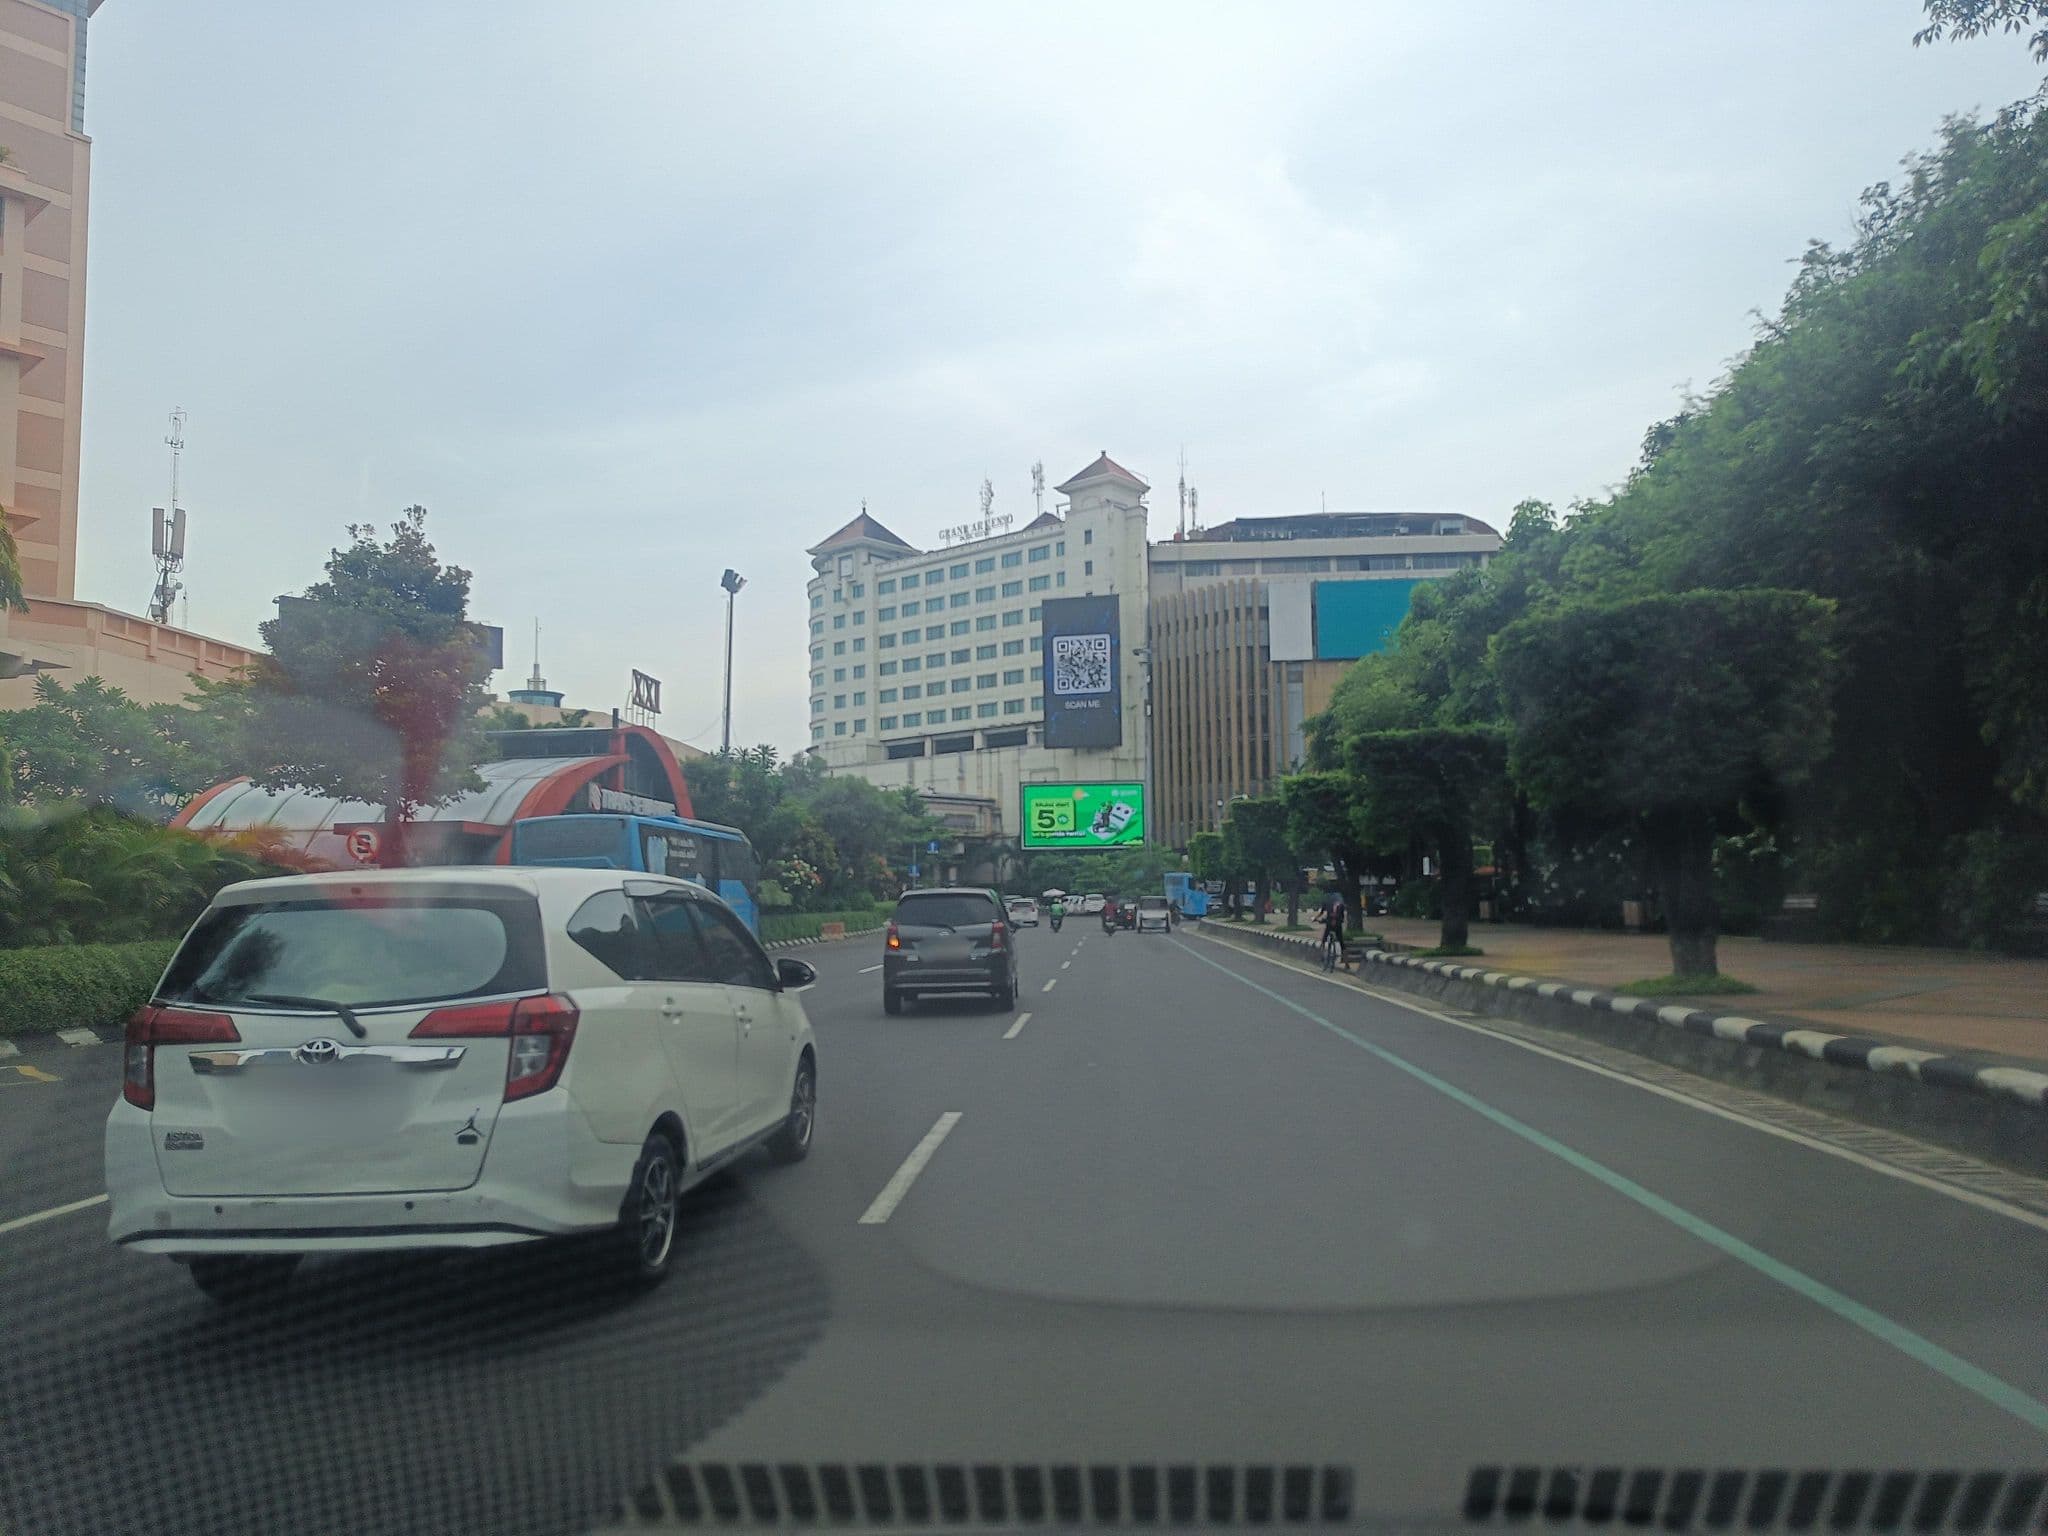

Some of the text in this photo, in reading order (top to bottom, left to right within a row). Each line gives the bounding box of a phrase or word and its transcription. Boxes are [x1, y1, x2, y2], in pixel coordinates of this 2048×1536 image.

[939, 524, 969, 540] GRAND
[632, 669, 662, 714] XXI
[1064, 699, 1101, 710] SCAN ME
[1038, 809, 1056, 829] 5
